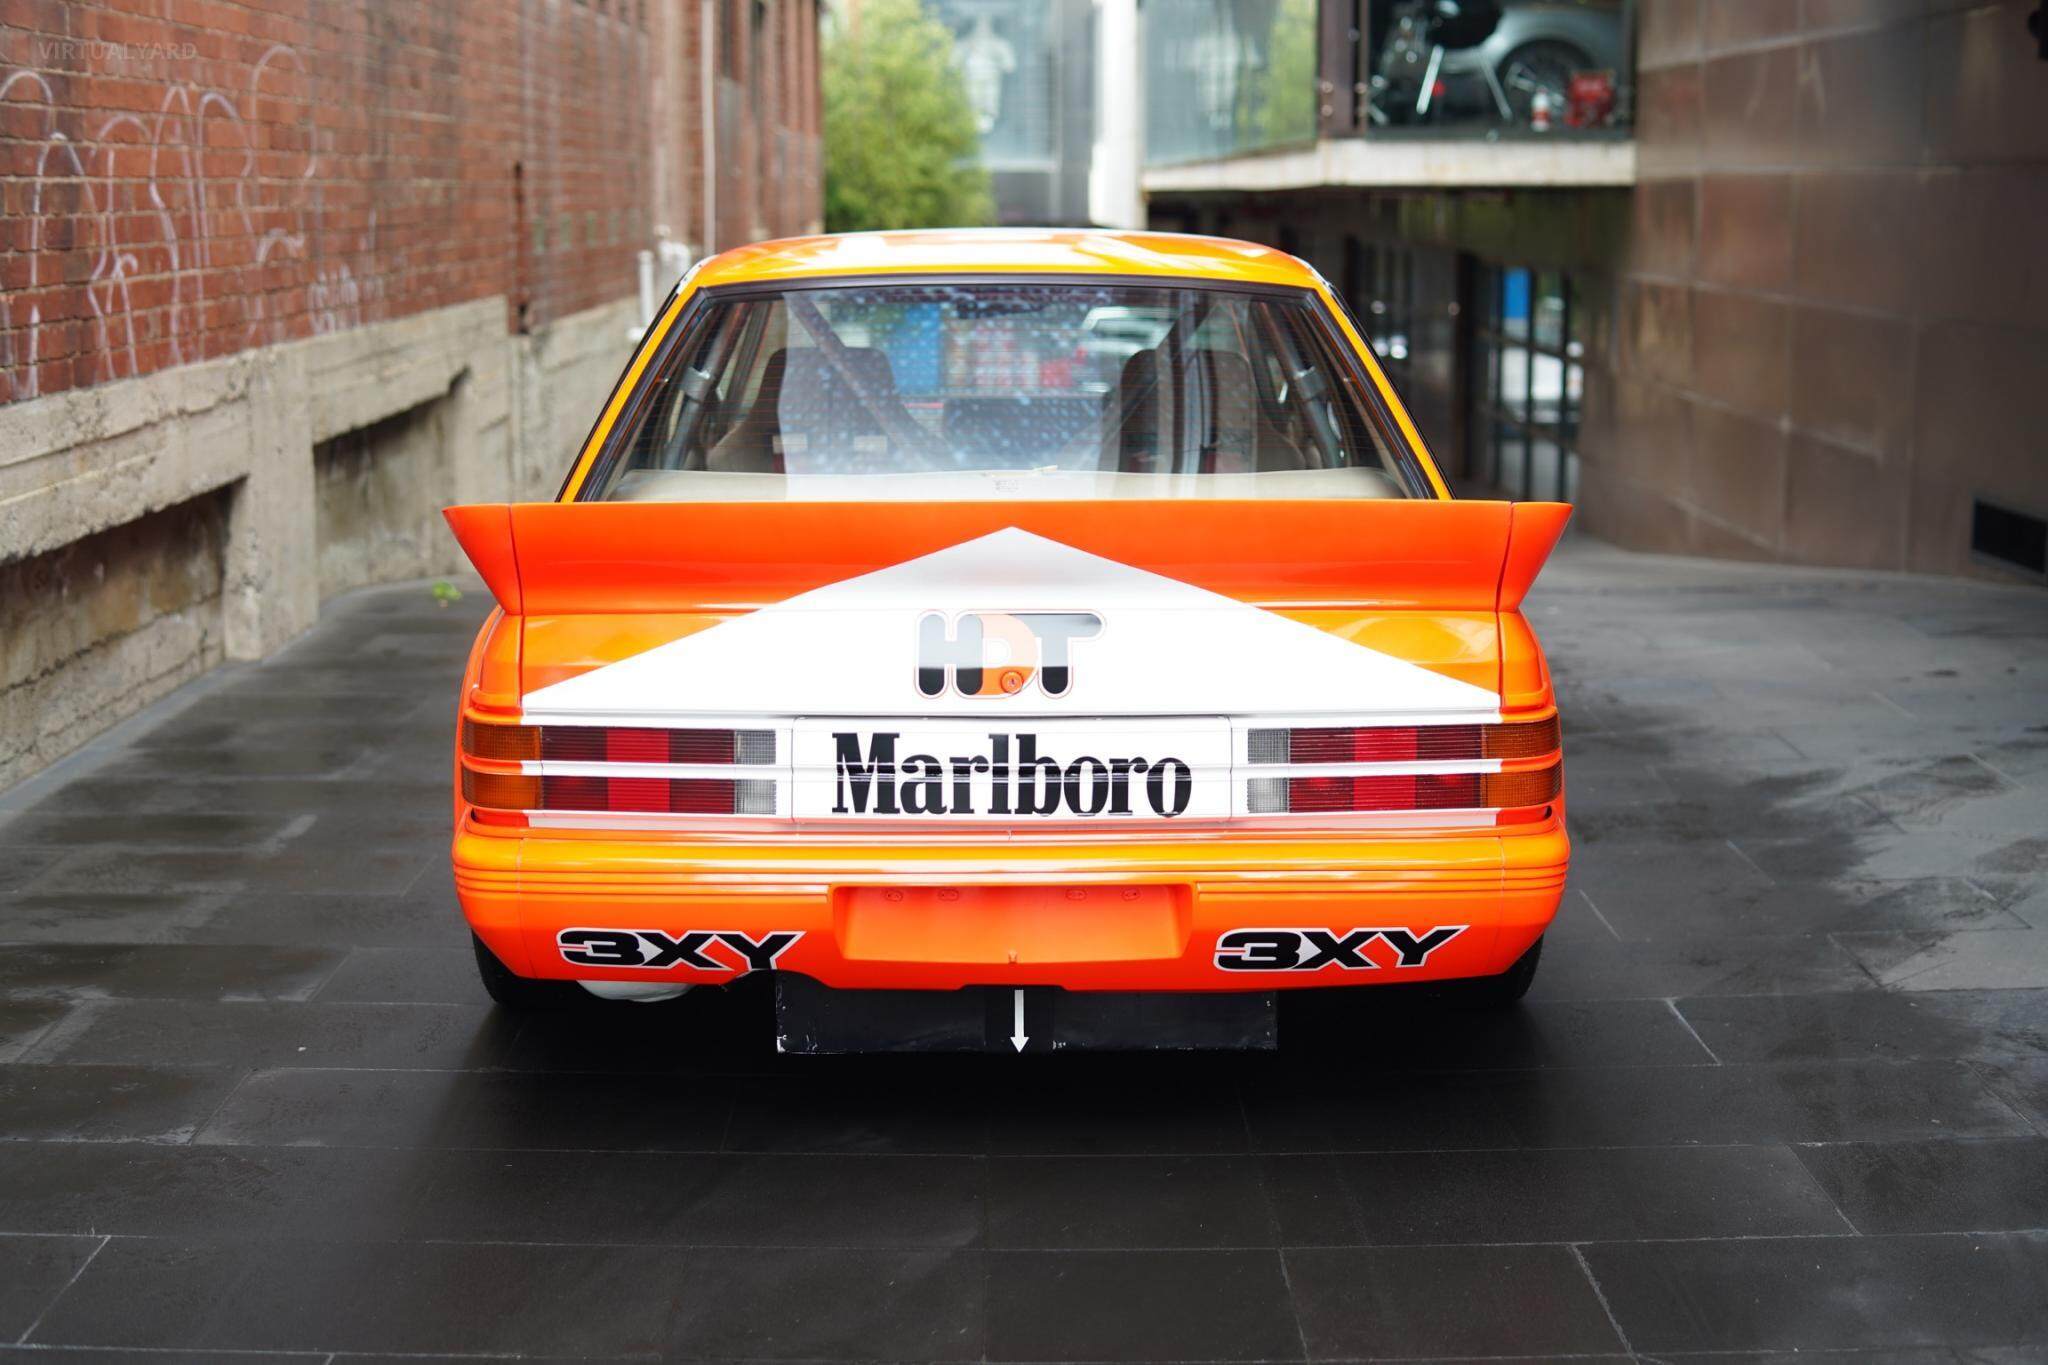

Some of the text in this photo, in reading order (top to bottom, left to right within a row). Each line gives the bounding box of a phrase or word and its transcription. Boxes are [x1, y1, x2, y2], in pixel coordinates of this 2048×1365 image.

[915, 610, 1106, 698] HDT
[832, 732, 1192, 817] Marlboro
[556, 927, 806, 971] 3XY
[1213, 925, 1471, 972] 3XY
